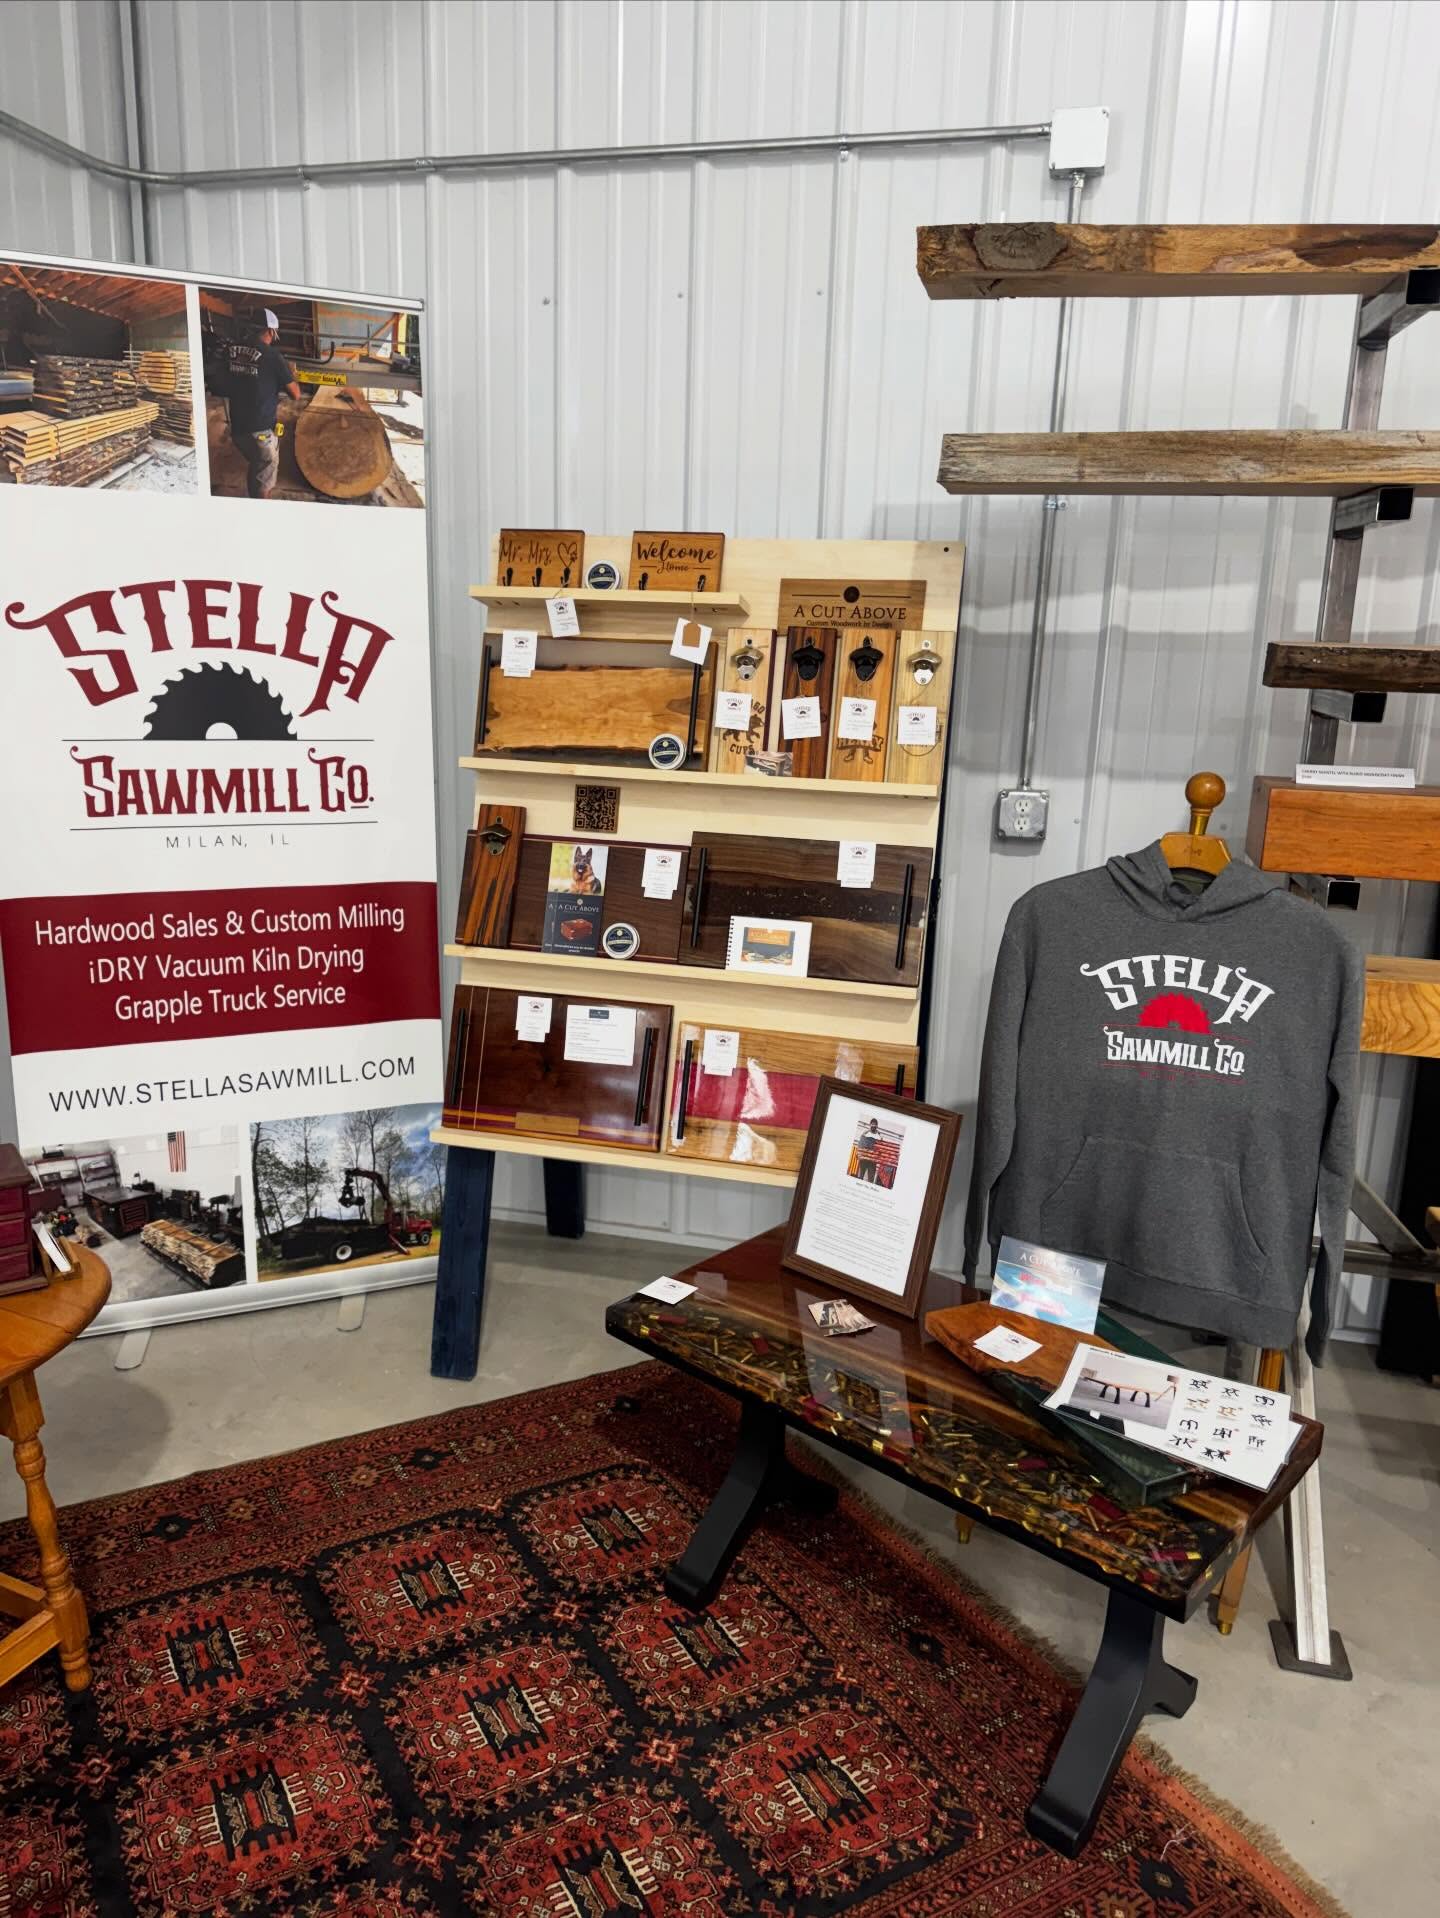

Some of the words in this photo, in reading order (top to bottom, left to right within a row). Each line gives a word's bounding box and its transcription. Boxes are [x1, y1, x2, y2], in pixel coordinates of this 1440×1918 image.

[637, 540, 717, 563] Welcome
[656, 561, 690, 574] Home
[794, 605, 806, 618] A
[811, 604, 846, 619] CUT
[850, 605, 907, 620] ABOVE
[5, 580, 396, 717] STELLA
[70, 746, 310, 817] SAWMILL
[166, 835, 248, 848] MILAN,
[271, 833, 290, 846] IL
[35, 914, 154, 945] Hardwood
[162, 911, 219, 938] Sales
[225, 910, 245, 936] &
[251, 908, 332, 933] Custom
[339, 902, 405, 933] Milling
[89, 954, 147, 984] iDRY
[156, 950, 245, 979] Vacuum
[252, 946, 291, 973] Kiln
[298, 943, 364, 975] Drying
[115, 990, 202, 1024] Grapple
[208, 984, 268, 1013] Truck
[273, 980, 346, 1008] Service
[1080, 954, 1276, 1024] STELLA
[1103, 1025, 1211, 1071] SAWMILL
[48, 1056, 416, 1113] WWW.STELLASAWMILL.COM
